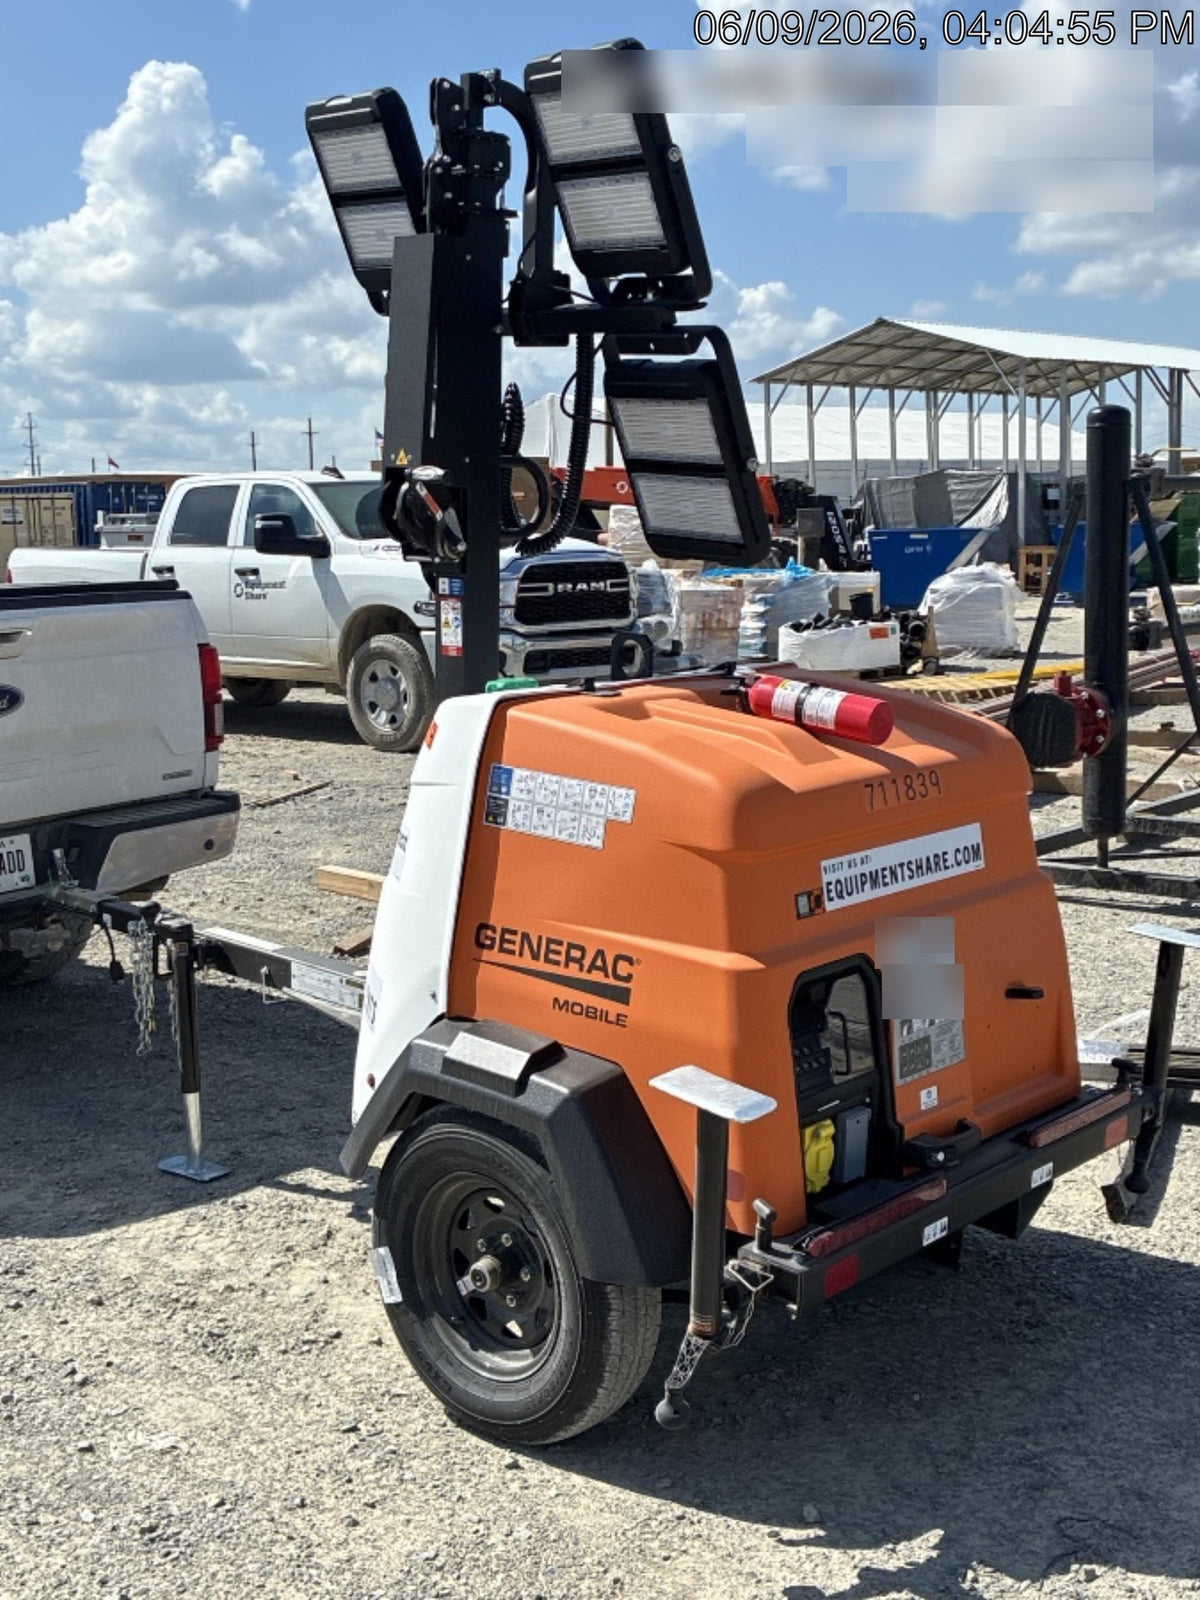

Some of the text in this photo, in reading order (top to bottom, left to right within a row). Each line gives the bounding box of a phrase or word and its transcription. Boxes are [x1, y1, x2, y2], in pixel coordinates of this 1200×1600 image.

[557, 580, 605, 593] RAM
[864, 770, 942, 810] 711839
[823, 861, 844, 875] VISIT
[848, 859, 857, 870] US
[825, 842, 982, 902] EQUIPMENTSHARE.COM
[474, 922, 634, 984] GENERAC
[552, 997, 628, 1028] MOBILE
